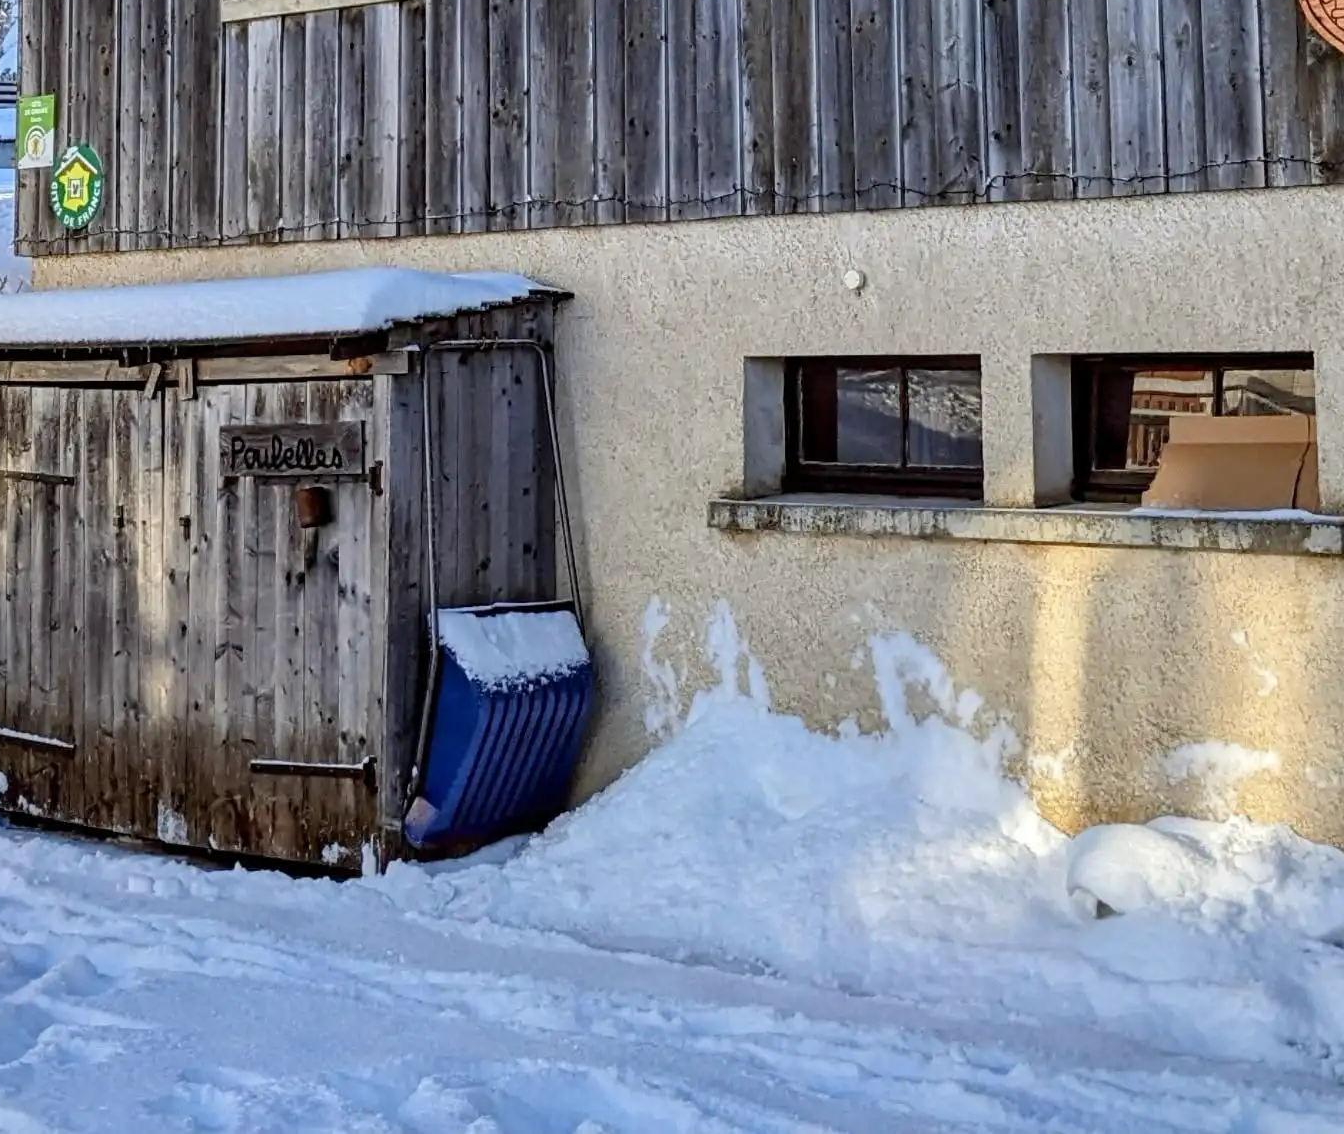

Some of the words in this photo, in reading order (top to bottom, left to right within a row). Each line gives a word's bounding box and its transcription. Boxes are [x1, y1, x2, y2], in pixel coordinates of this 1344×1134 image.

[63, 214, 75, 227] DE
[77, 180, 101, 226] FRANCE
[231, 434, 343, 472] Poubelles
